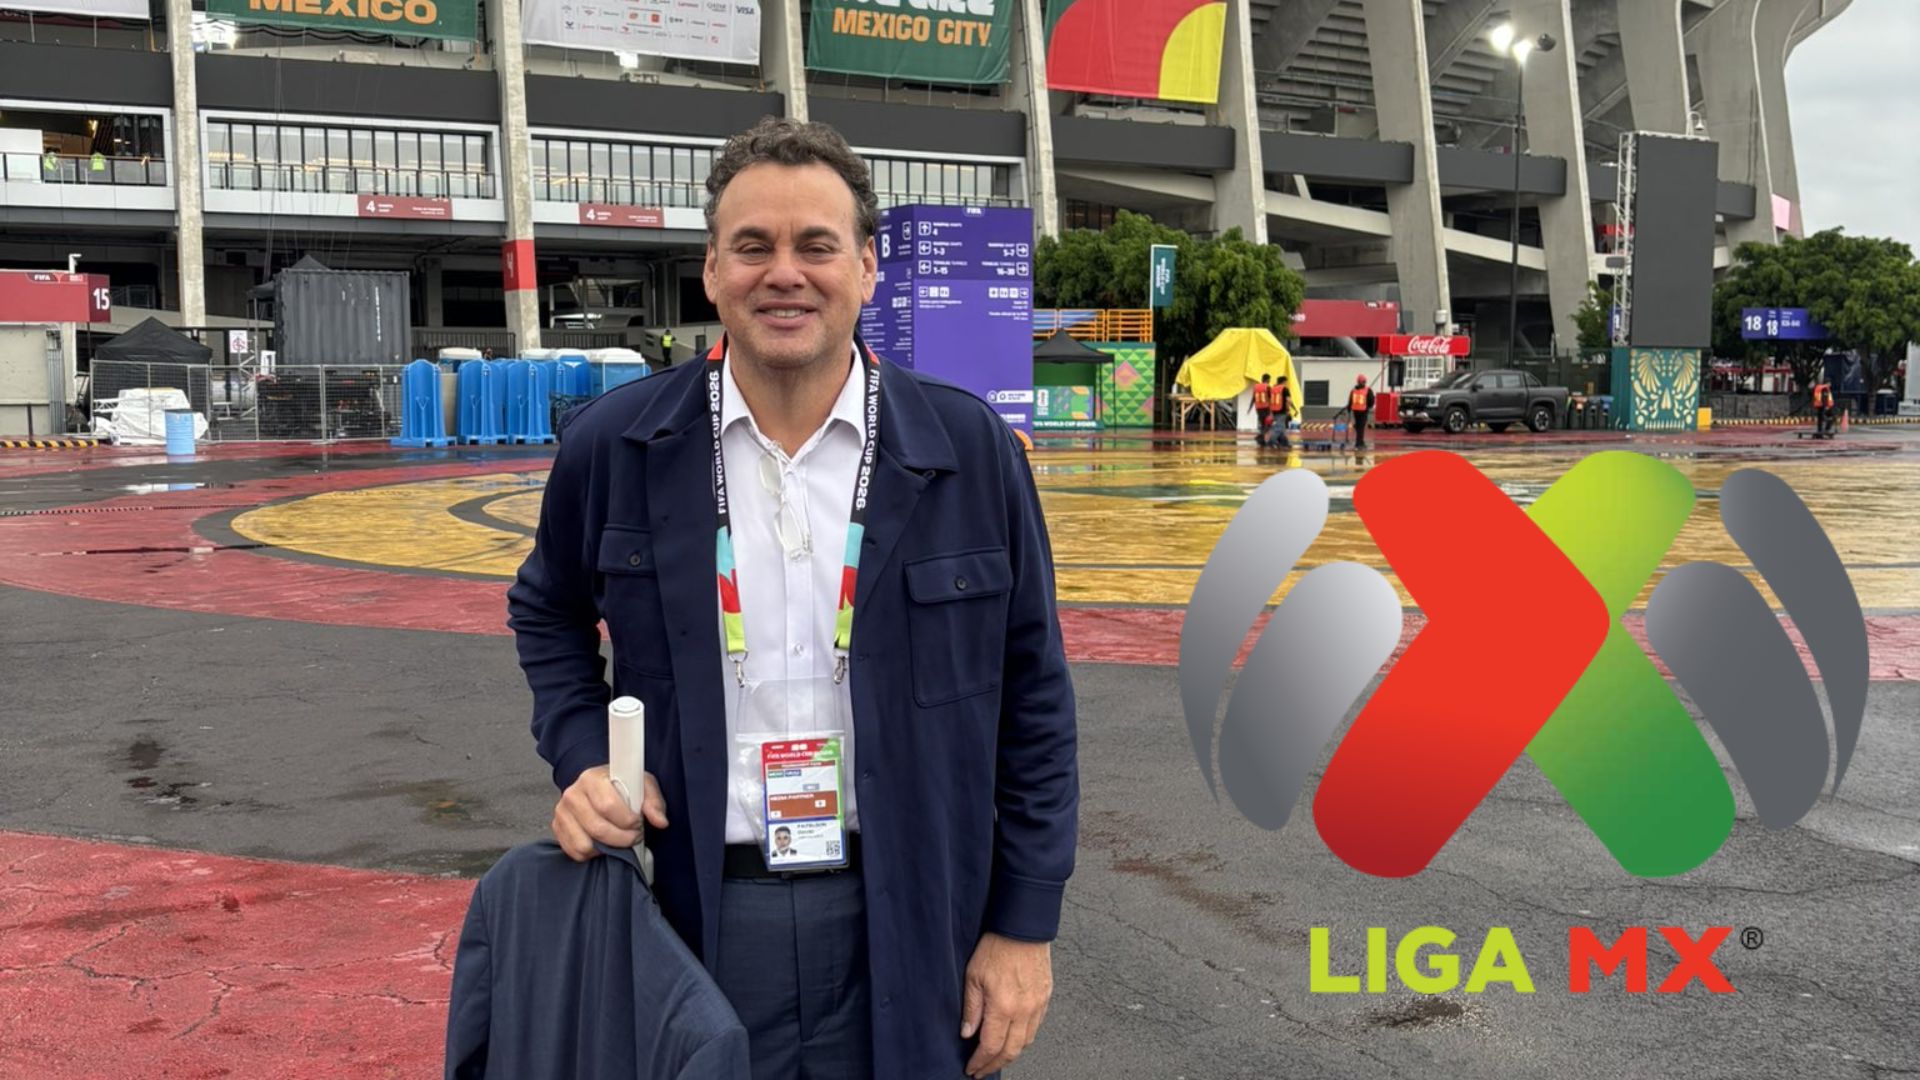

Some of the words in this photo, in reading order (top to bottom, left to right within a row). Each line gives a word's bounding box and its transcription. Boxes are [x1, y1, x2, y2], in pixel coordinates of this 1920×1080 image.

[833, 7, 931, 42] MEXICO
[937, 18, 992, 47] CITY
[366, 200, 376, 212] 4
[586, 208, 596, 220] 4
[881, 233, 891, 258] B
[34, 273, 51, 281] FIFA
[93, 287, 110, 310] 15
[1744, 315, 1762, 331] 18
[1766, 320, 1779, 336] 18
[709, 370, 720, 412] 2026
[867, 369, 880, 394] FIFA
[711, 414, 721, 439] CUP
[866, 394, 878, 439] WORLD
[713, 441, 725, 485] WORLD
[863, 439, 875, 464] CUP
[717, 486, 727, 515] FIFA
[856, 465, 871, 511] 2026
